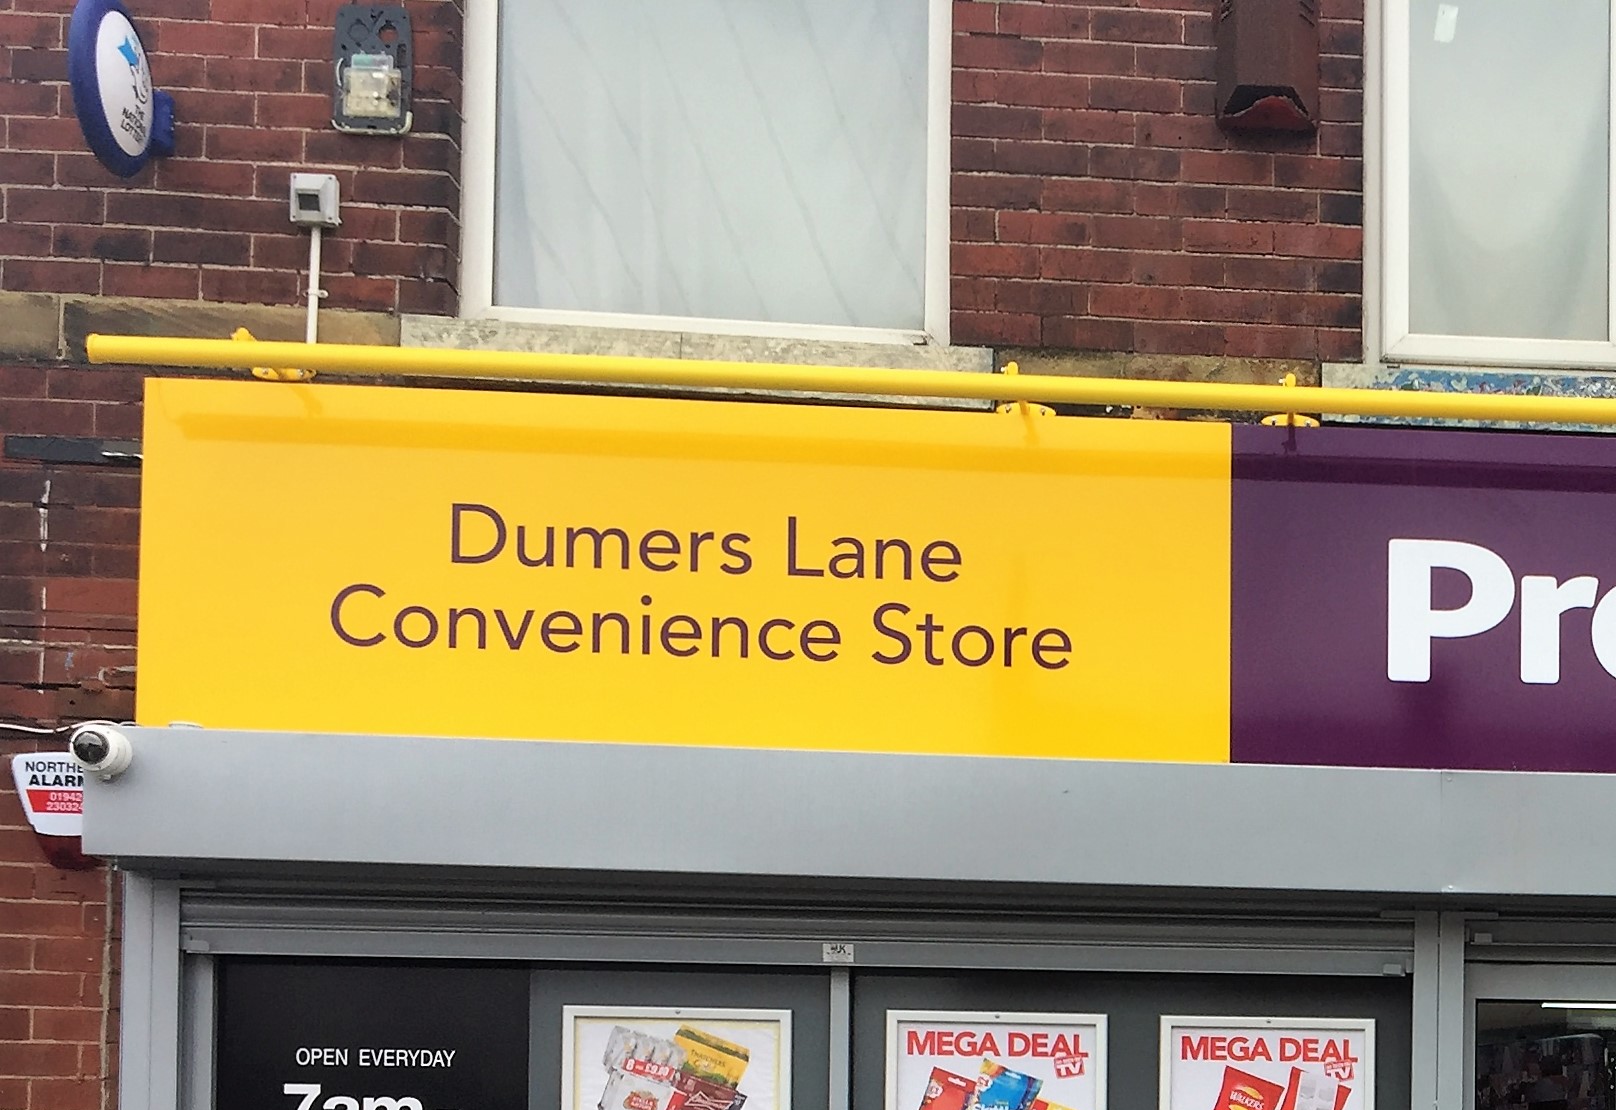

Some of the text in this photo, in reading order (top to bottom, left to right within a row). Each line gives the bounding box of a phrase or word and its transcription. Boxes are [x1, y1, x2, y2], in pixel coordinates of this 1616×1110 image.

[451, 502, 962, 582] Dumers Lane
[330, 582, 1072, 670] Convenience Store
[906, 1030, 1088, 1058] MEGA DEAL
[1181, 1036, 1358, 1062] MEGA DEAL
[296, 1048, 456, 1068] OPEN EVERYDAY
[1057, 1062, 1082, 1076] TV
